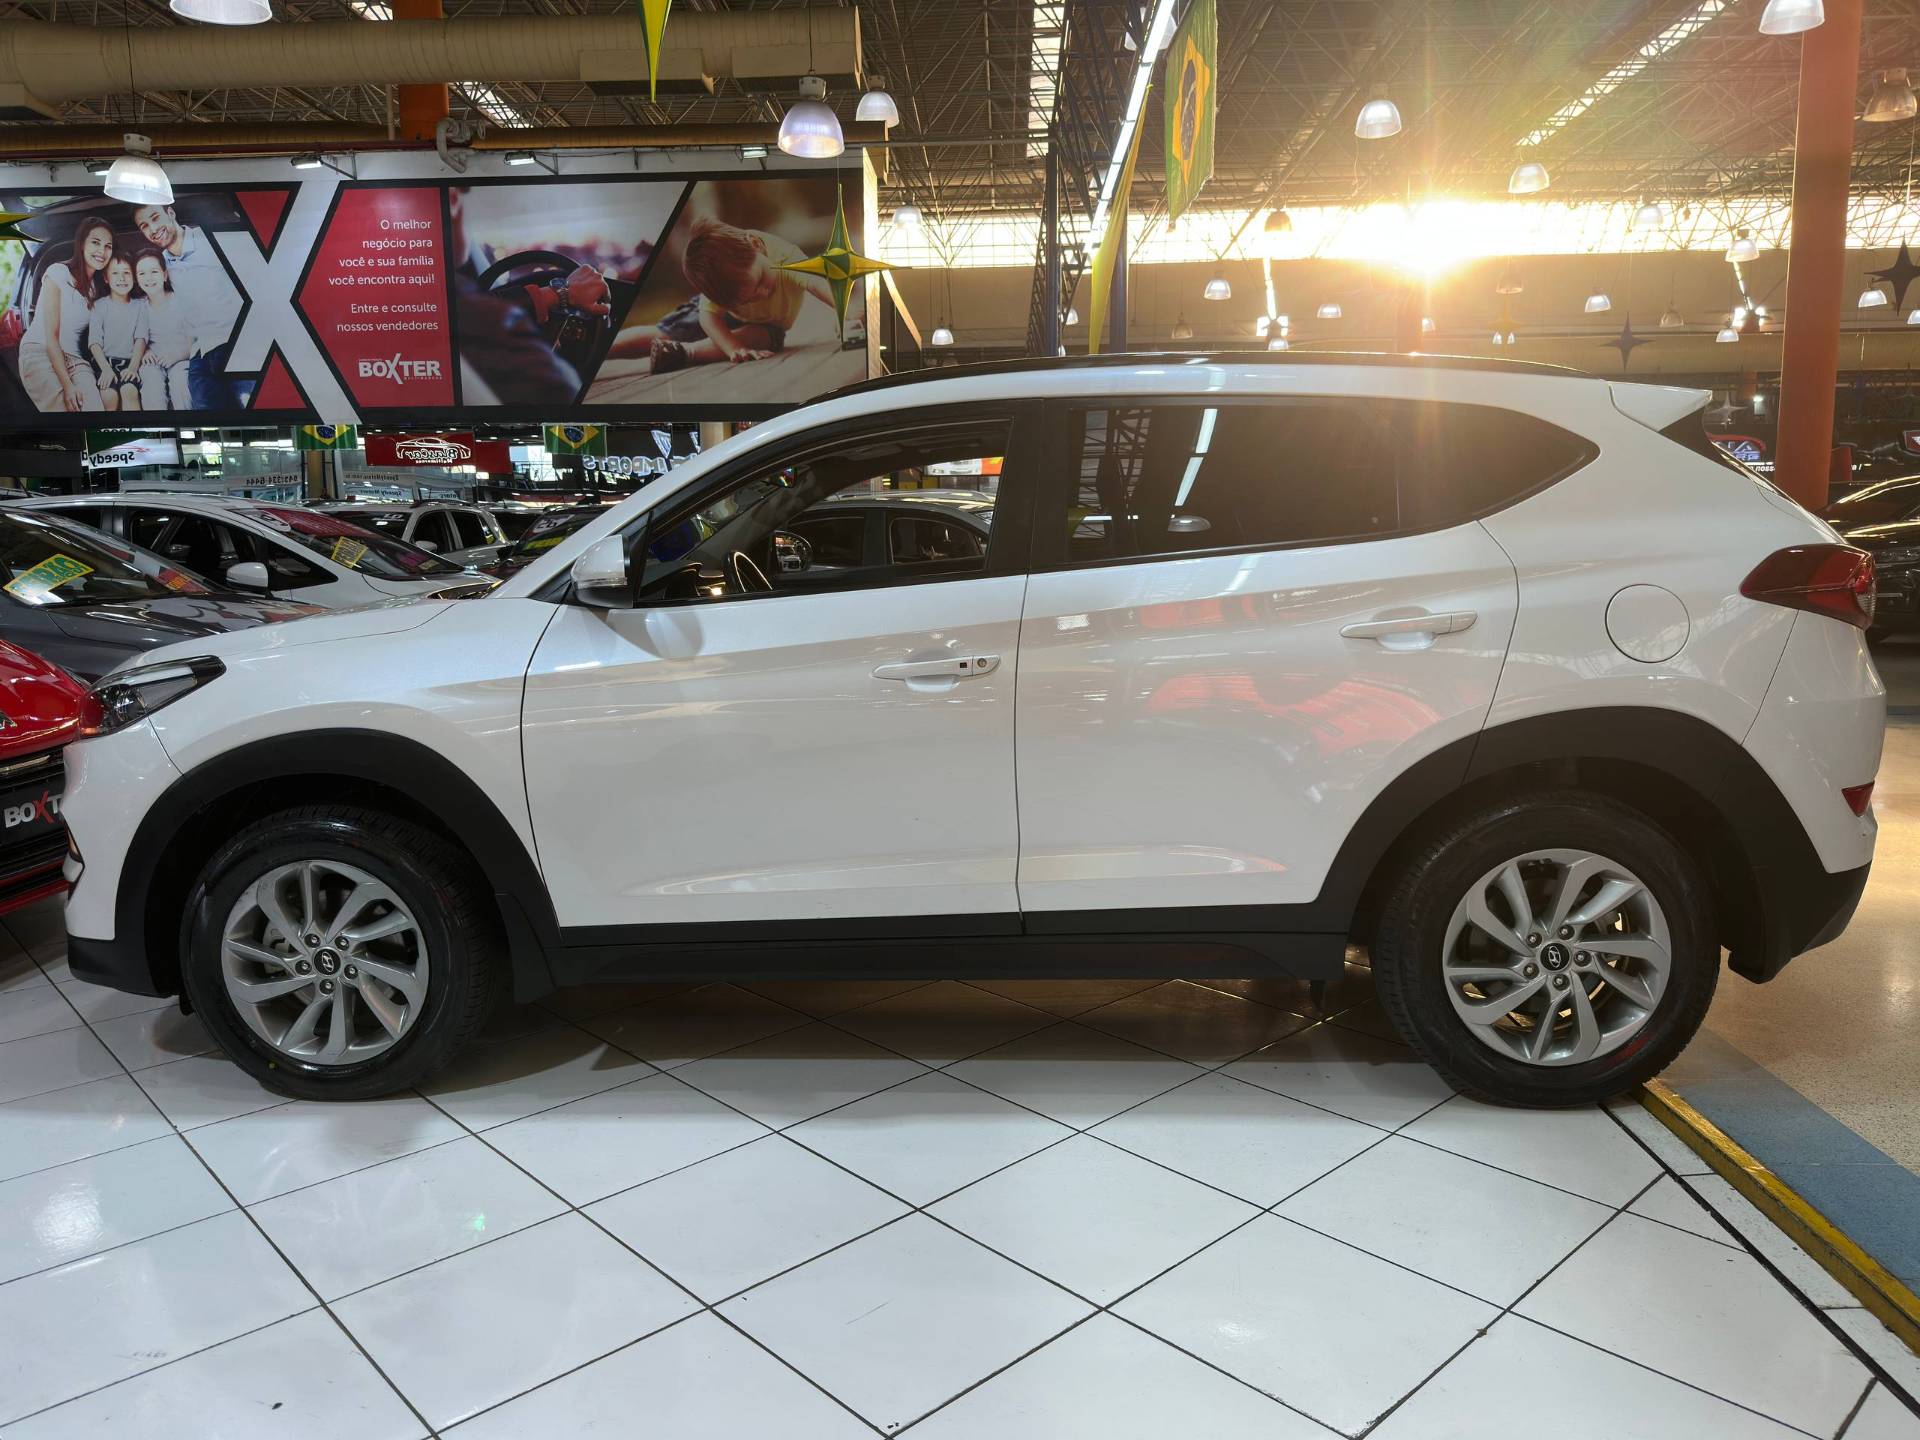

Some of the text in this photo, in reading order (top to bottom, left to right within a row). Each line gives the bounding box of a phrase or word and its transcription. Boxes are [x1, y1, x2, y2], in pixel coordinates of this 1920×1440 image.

[380, 219, 432, 230] O melhor
[362, 238, 433, 251] negócio para
[339, 256, 365, 267] você
[377, 258, 396, 266] sua
[398, 255, 434, 266] família
[328, 274, 435, 287] você encontra aqui!
[351, 302, 437, 314] Entre e consulte
[337, 320, 439, 332] nossos vendedores
[358, 352, 442, 385] BOXTER
[3, 790, 63, 828] BOXT
